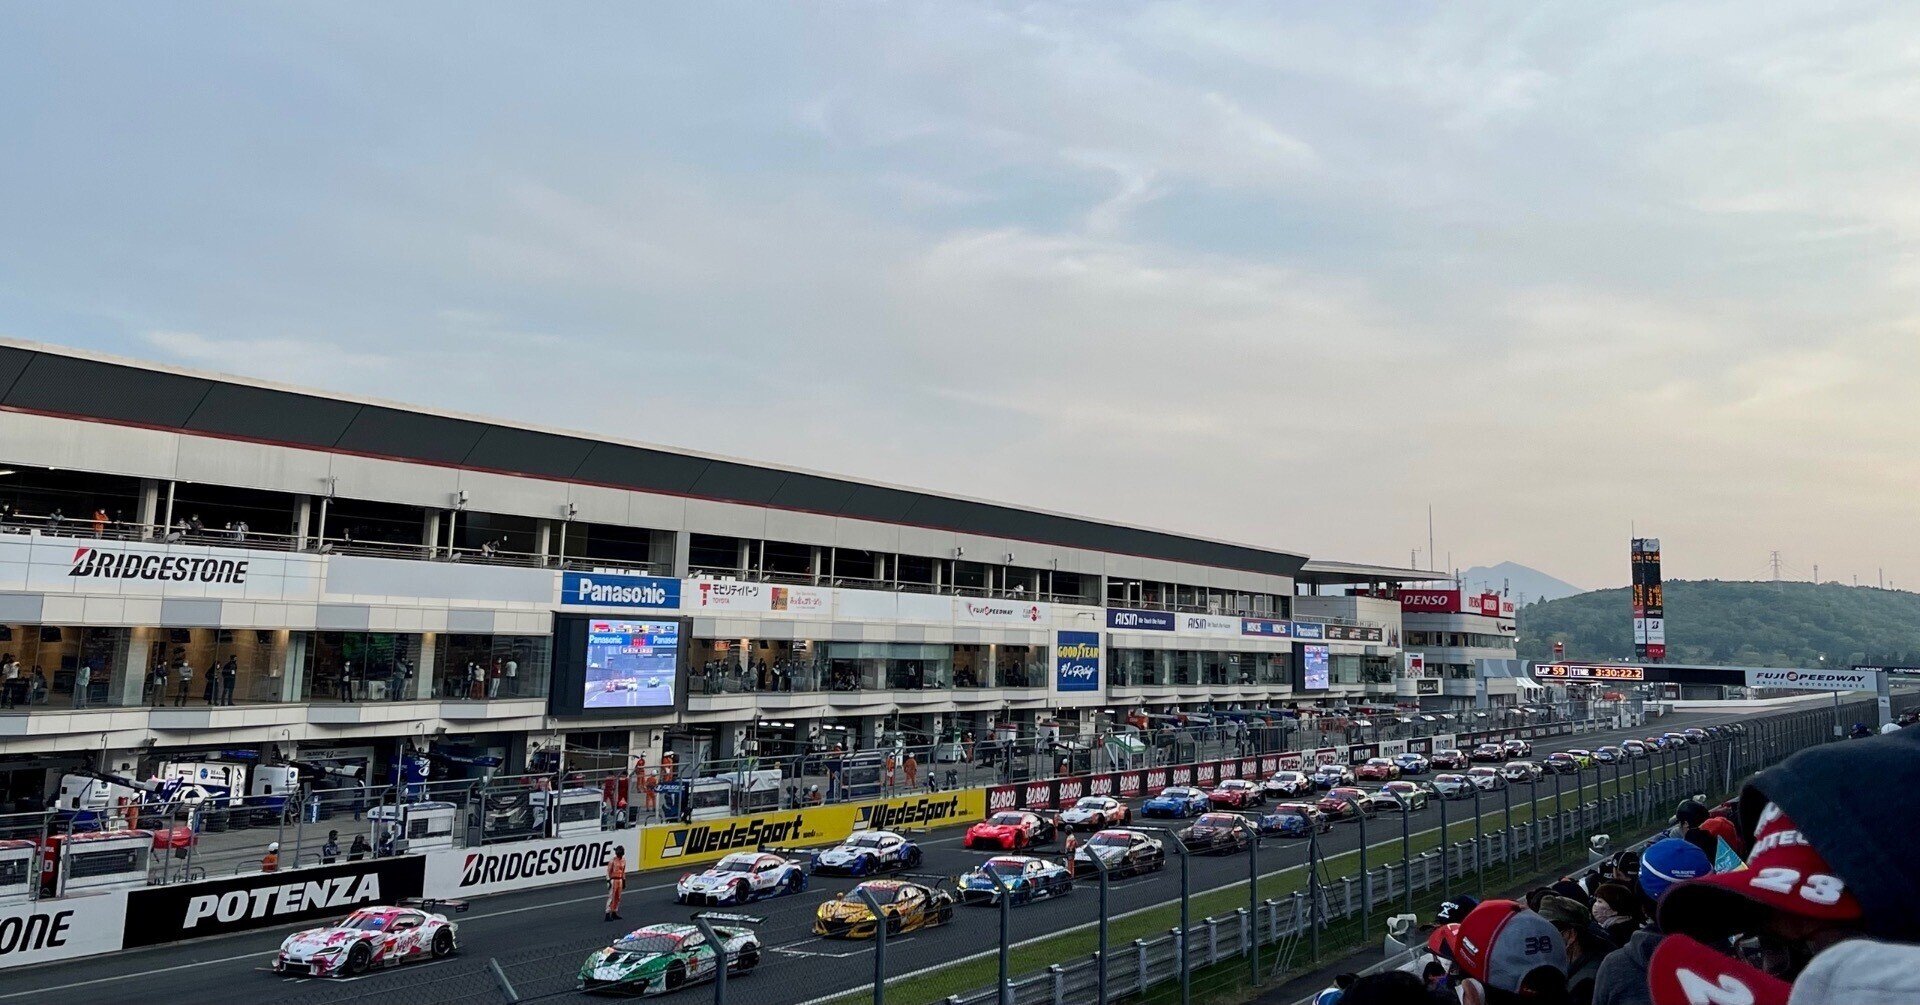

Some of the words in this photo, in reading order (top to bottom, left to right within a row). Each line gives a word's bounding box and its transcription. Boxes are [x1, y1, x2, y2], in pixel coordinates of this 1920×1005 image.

[68, 546, 249, 583] BRIDGESTONE
[579, 578, 666, 604] Panasonic
[1404, 595, 1448, 605] DENSO
[1115, 612, 1138, 625] AISIN
[1188, 618, 1206, 629] AISIN
[590, 634, 622, 644] Panasonic
[1537, 667, 1550, 675] LAP
[1552, 666, 1565, 675] 59
[1572, 668, 1589, 676] TIME
[1595, 668, 1642, 678] 3:30:22.2
[1756, 672, 1784, 680] FUJI
[1786, 671, 1865, 682] SPEEDWAY
[870, 795, 958, 829] WedsSport
[684, 814, 803, 855] WedsSport
[459, 841, 613, 887] BRIDGESTONE
[1750, 867, 1844, 905] 23
[183, 873, 380, 928] POTENZA
[1525, 935, 1552, 955] 38
